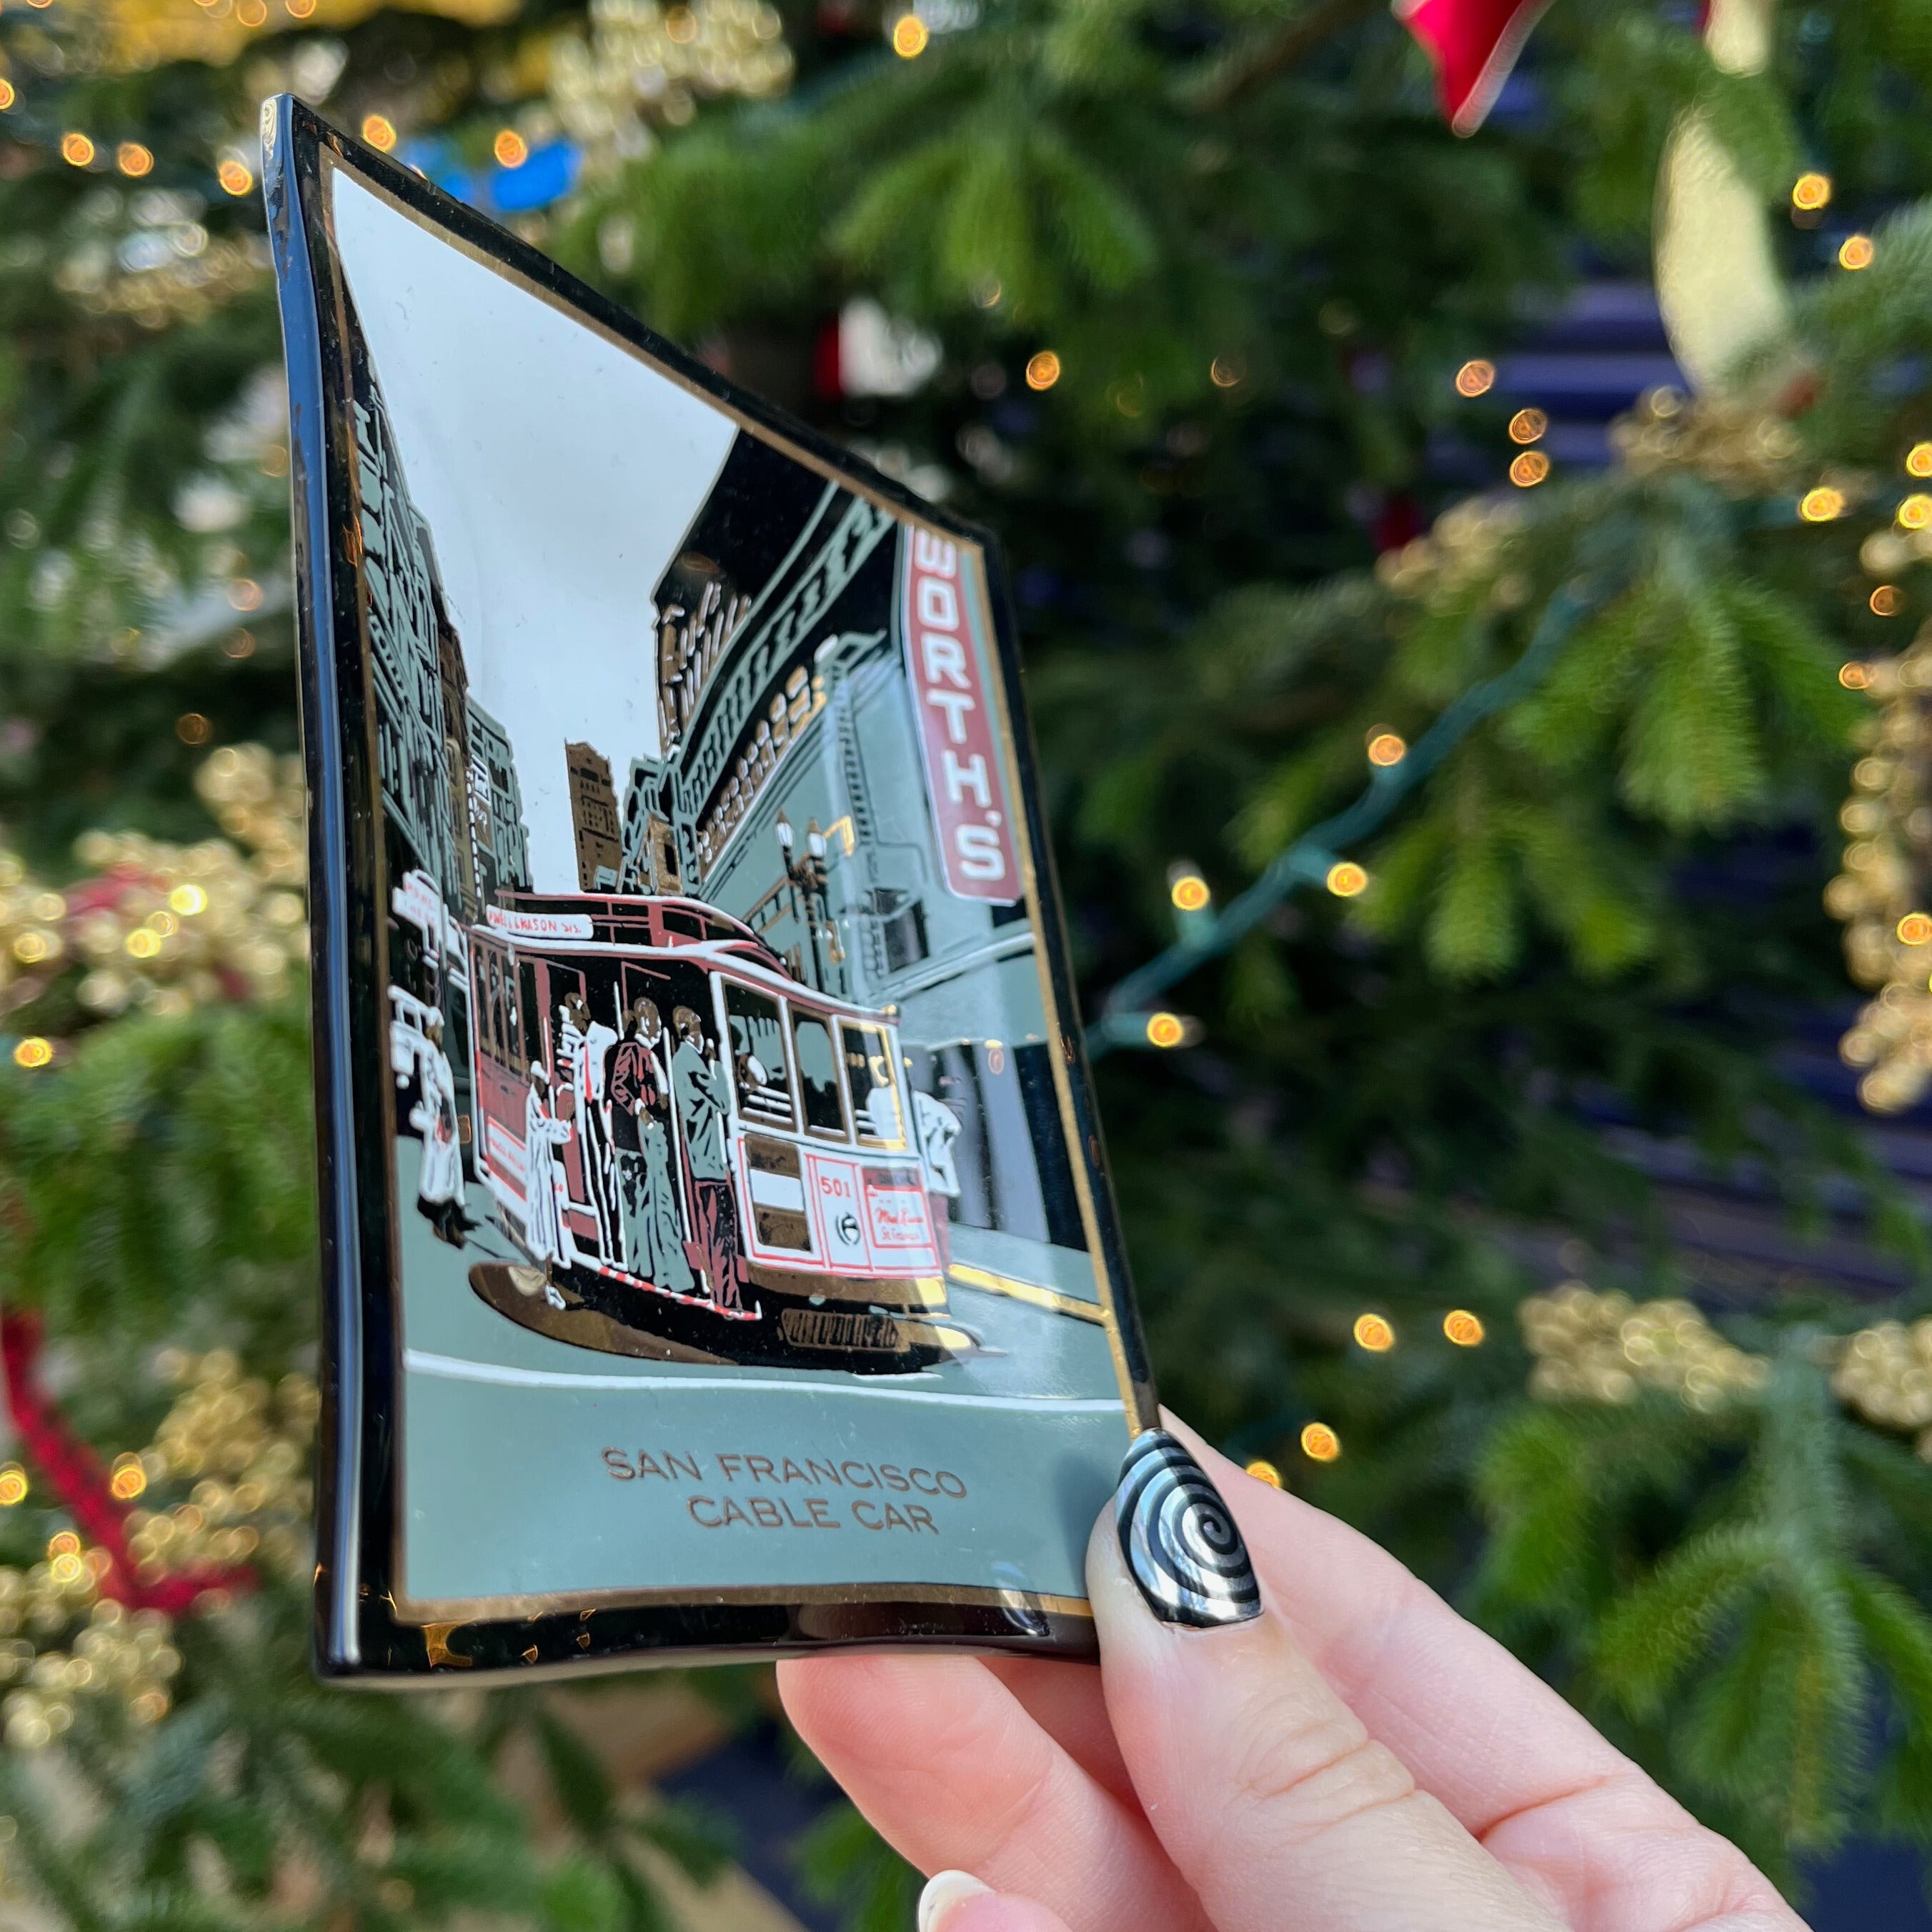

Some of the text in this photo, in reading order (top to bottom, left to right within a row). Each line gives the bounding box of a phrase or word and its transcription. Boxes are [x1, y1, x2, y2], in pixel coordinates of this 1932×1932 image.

[820, 1176, 851, 1197] 501
[601, 1446, 967, 1498] SAN FRANCISCO
[687, 1495, 940, 1535] CABLE CAR
